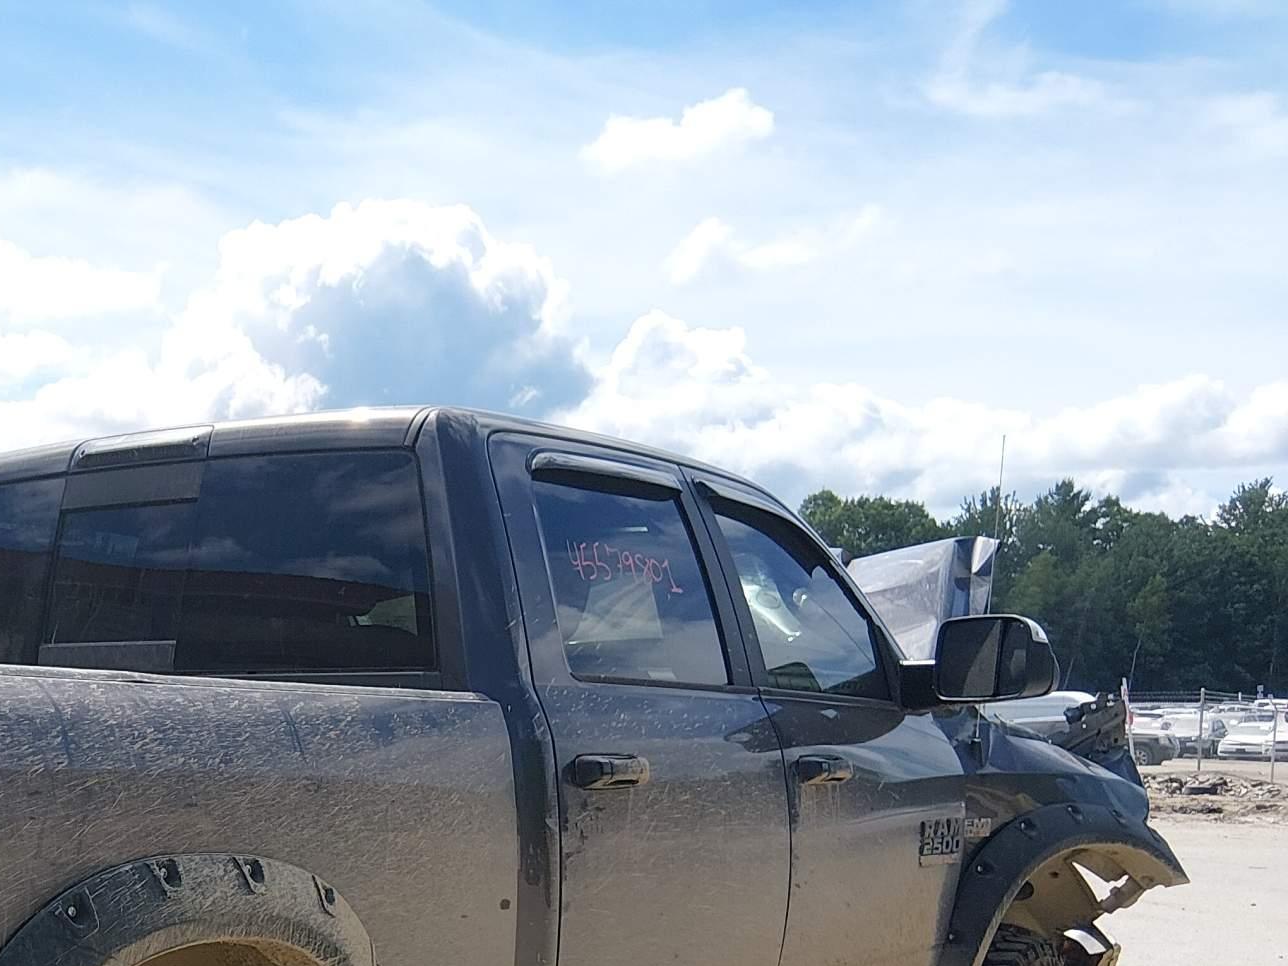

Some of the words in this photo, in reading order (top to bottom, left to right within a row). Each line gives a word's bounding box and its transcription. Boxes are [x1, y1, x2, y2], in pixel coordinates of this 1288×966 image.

[566, 538, 684, 594] 45579801
[923, 818, 961, 838] RAM
[922, 836, 961, 855] 2500
